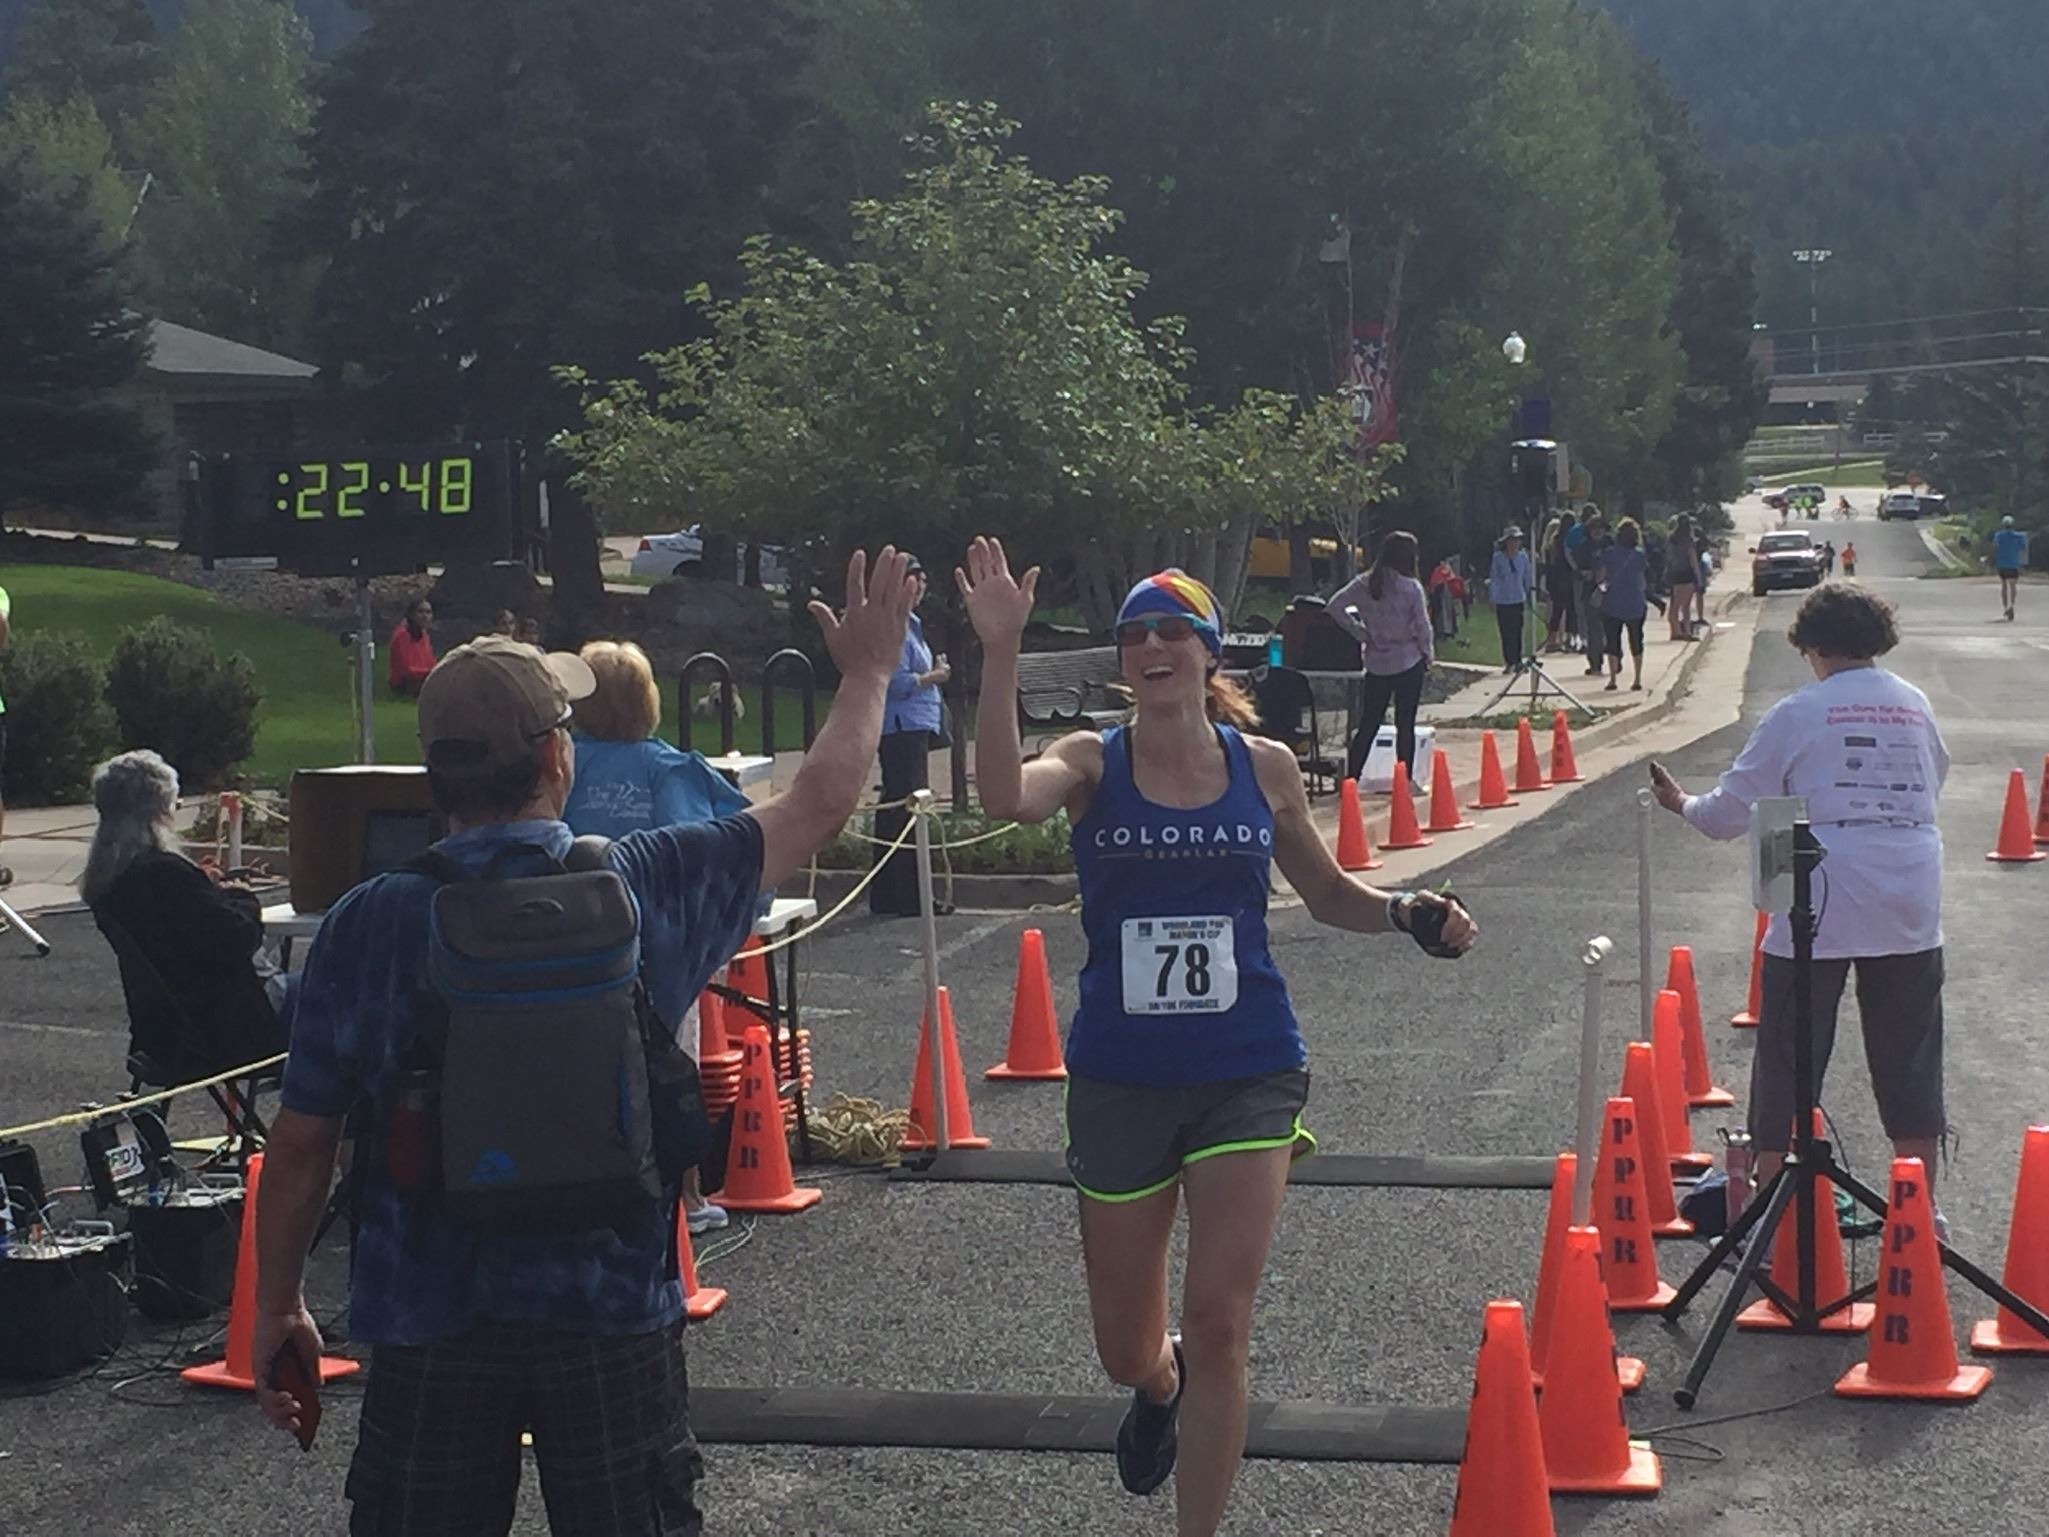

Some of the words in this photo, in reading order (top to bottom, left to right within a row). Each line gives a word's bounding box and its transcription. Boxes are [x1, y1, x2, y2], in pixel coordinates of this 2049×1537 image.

[1095, 825, 1271, 847] COLORADO
[1154, 943, 1211, 998] 78
[1884, 1180, 1919, 1345] PPRR
